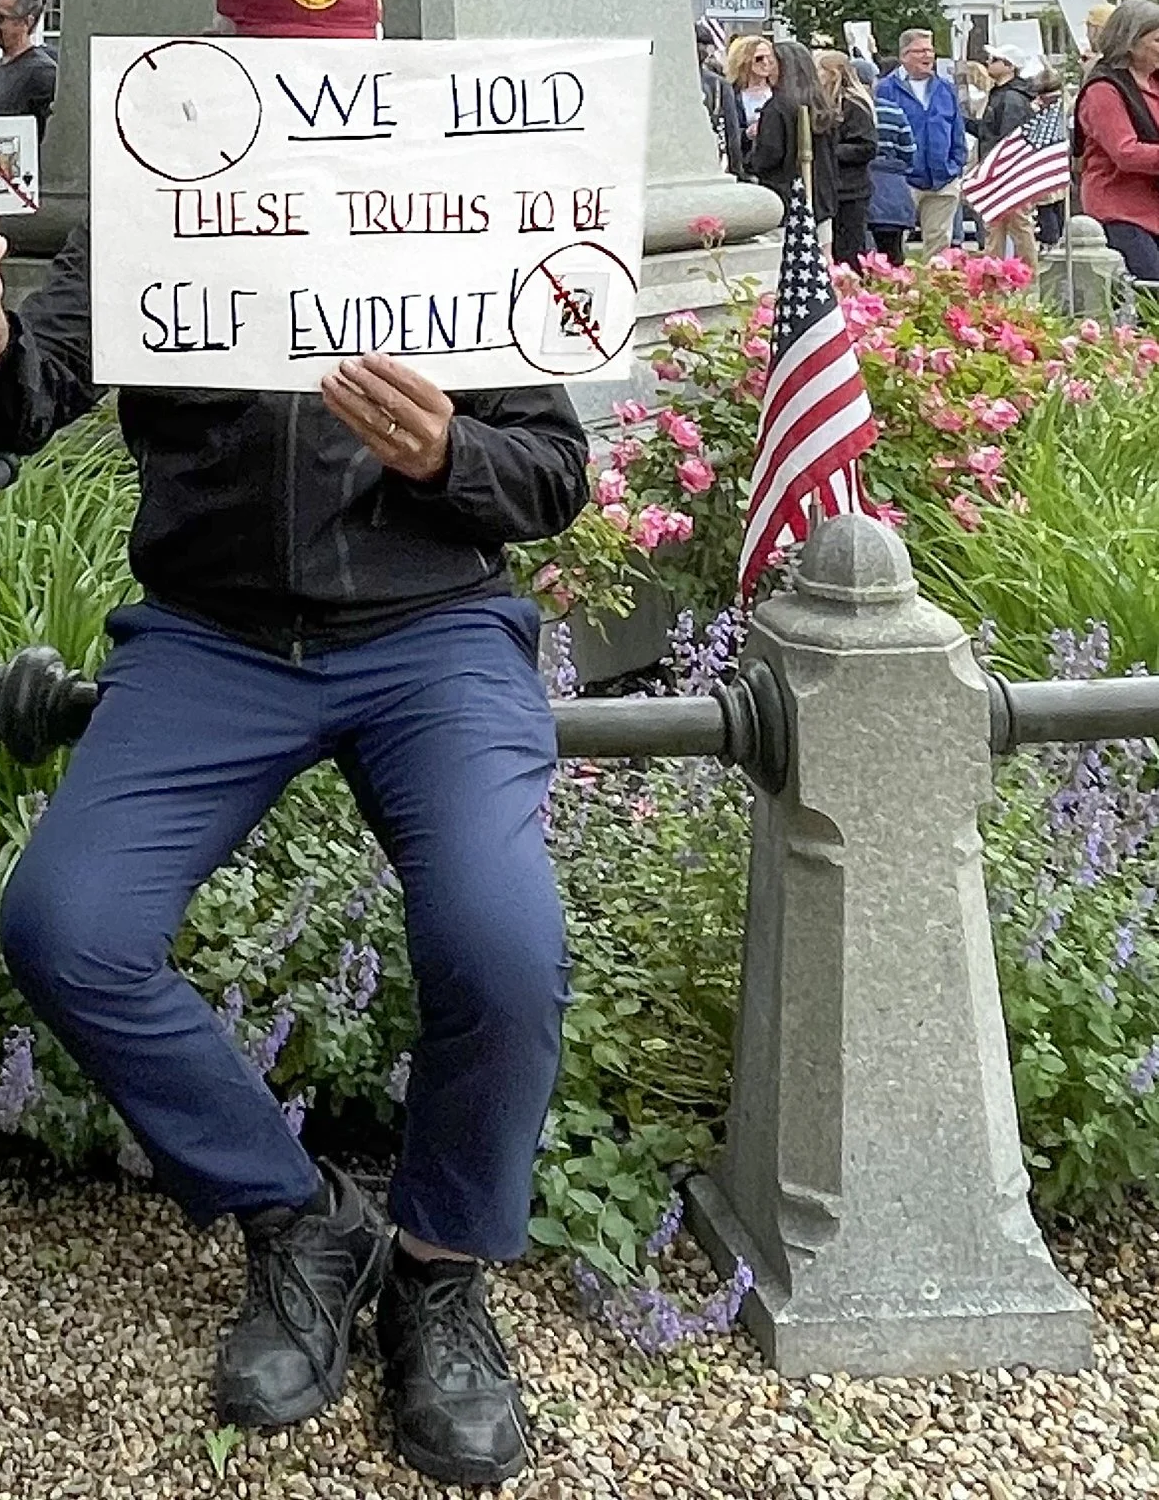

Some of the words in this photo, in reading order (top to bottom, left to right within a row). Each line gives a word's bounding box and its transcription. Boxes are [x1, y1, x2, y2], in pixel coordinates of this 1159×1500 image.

[275, 71, 398, 128] WE
[450, 71, 585, 129] HOLD
[155, 188, 306, 236] THESE
[335, 189, 490, 233] TRUTHS
[512, 190, 555, 231] TO
[572, 185, 617, 229] BE
[140, 281, 258, 351] SELF
